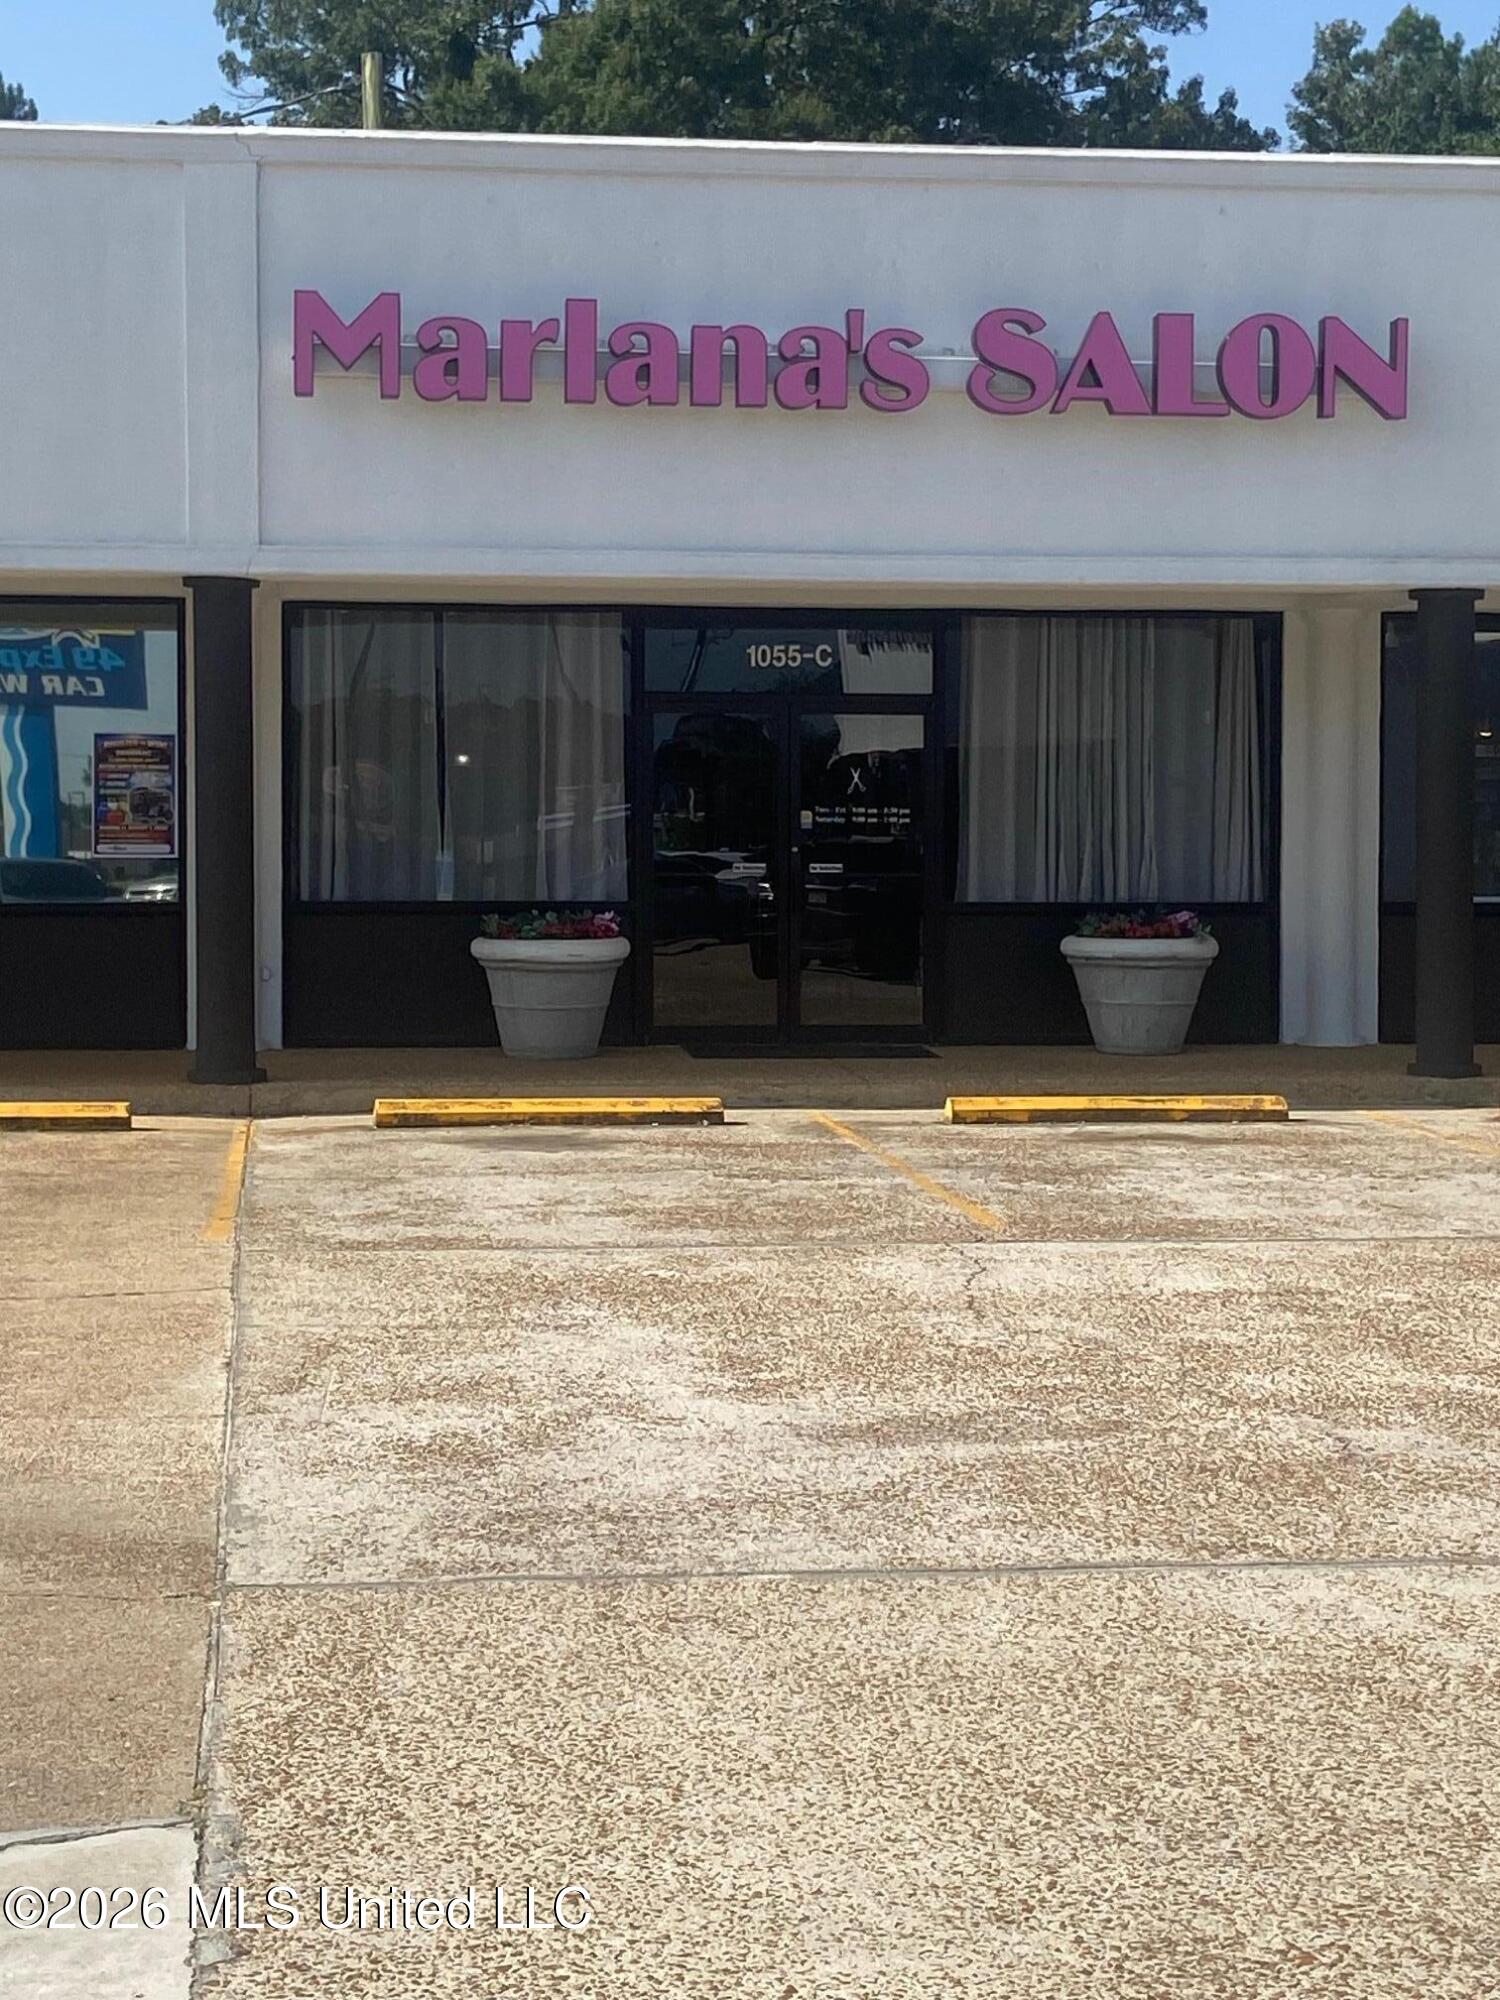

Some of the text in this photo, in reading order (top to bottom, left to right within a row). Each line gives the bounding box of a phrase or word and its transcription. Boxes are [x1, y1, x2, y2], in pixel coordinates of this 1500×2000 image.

[293, 290, 1409, 420] Marlana's SALON
[746, 644, 833, 668] 1055-C
